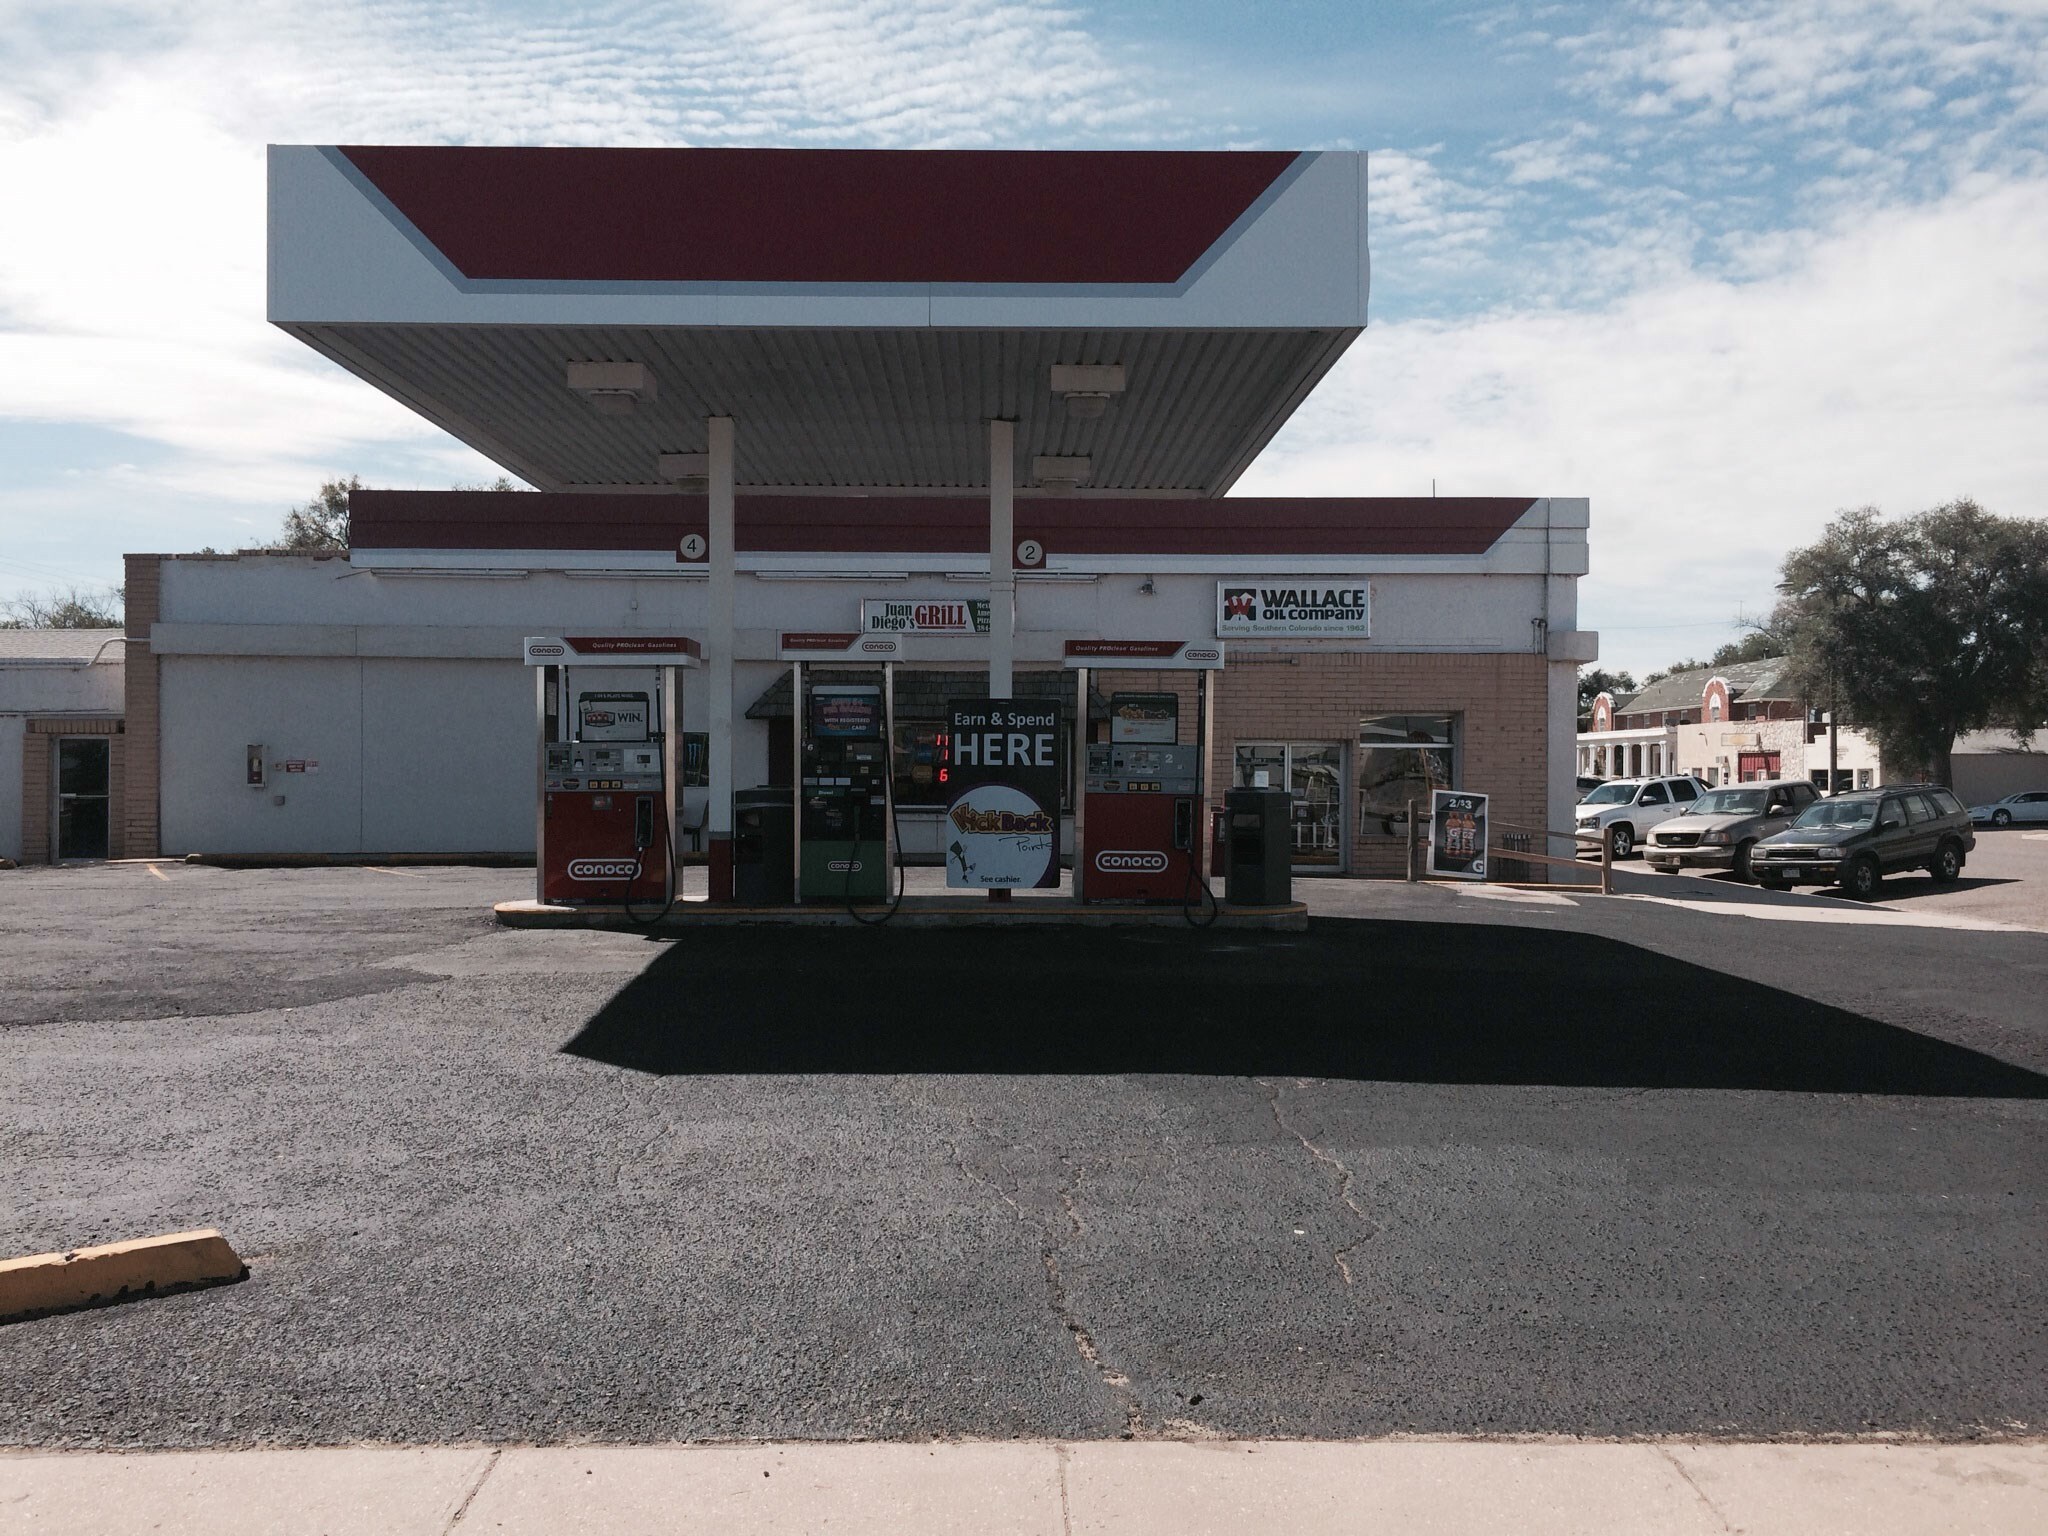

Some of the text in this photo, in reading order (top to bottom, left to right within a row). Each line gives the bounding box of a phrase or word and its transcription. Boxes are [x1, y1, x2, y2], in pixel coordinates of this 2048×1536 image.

[686, 538, 697, 553] 4
[1025, 545, 1035, 560] 2
[1260, 589, 1365, 608] WALLACE
[884, 603, 912, 617] Juan
[1262, 609, 1286, 620] OIL
[872, 616, 915, 631] Diego's
[1222, 624, 1250, 632] Serving
[617, 712, 643, 723] WIN.
[954, 712, 1055, 729] Earn & Spend
[954, 733, 1055, 766] HERE
[1165, 753, 1173, 763] 2
[939, 768, 948, 782] 6
[1448, 798, 1473, 810] 2/$3
[950, 803, 1052, 834] KickBack
[1101, 855, 1163, 868] conoco
[1472, 860, 1484, 873] G
[573, 863, 636, 876] conoco
[980, 875, 1022, 883] See cashier.
